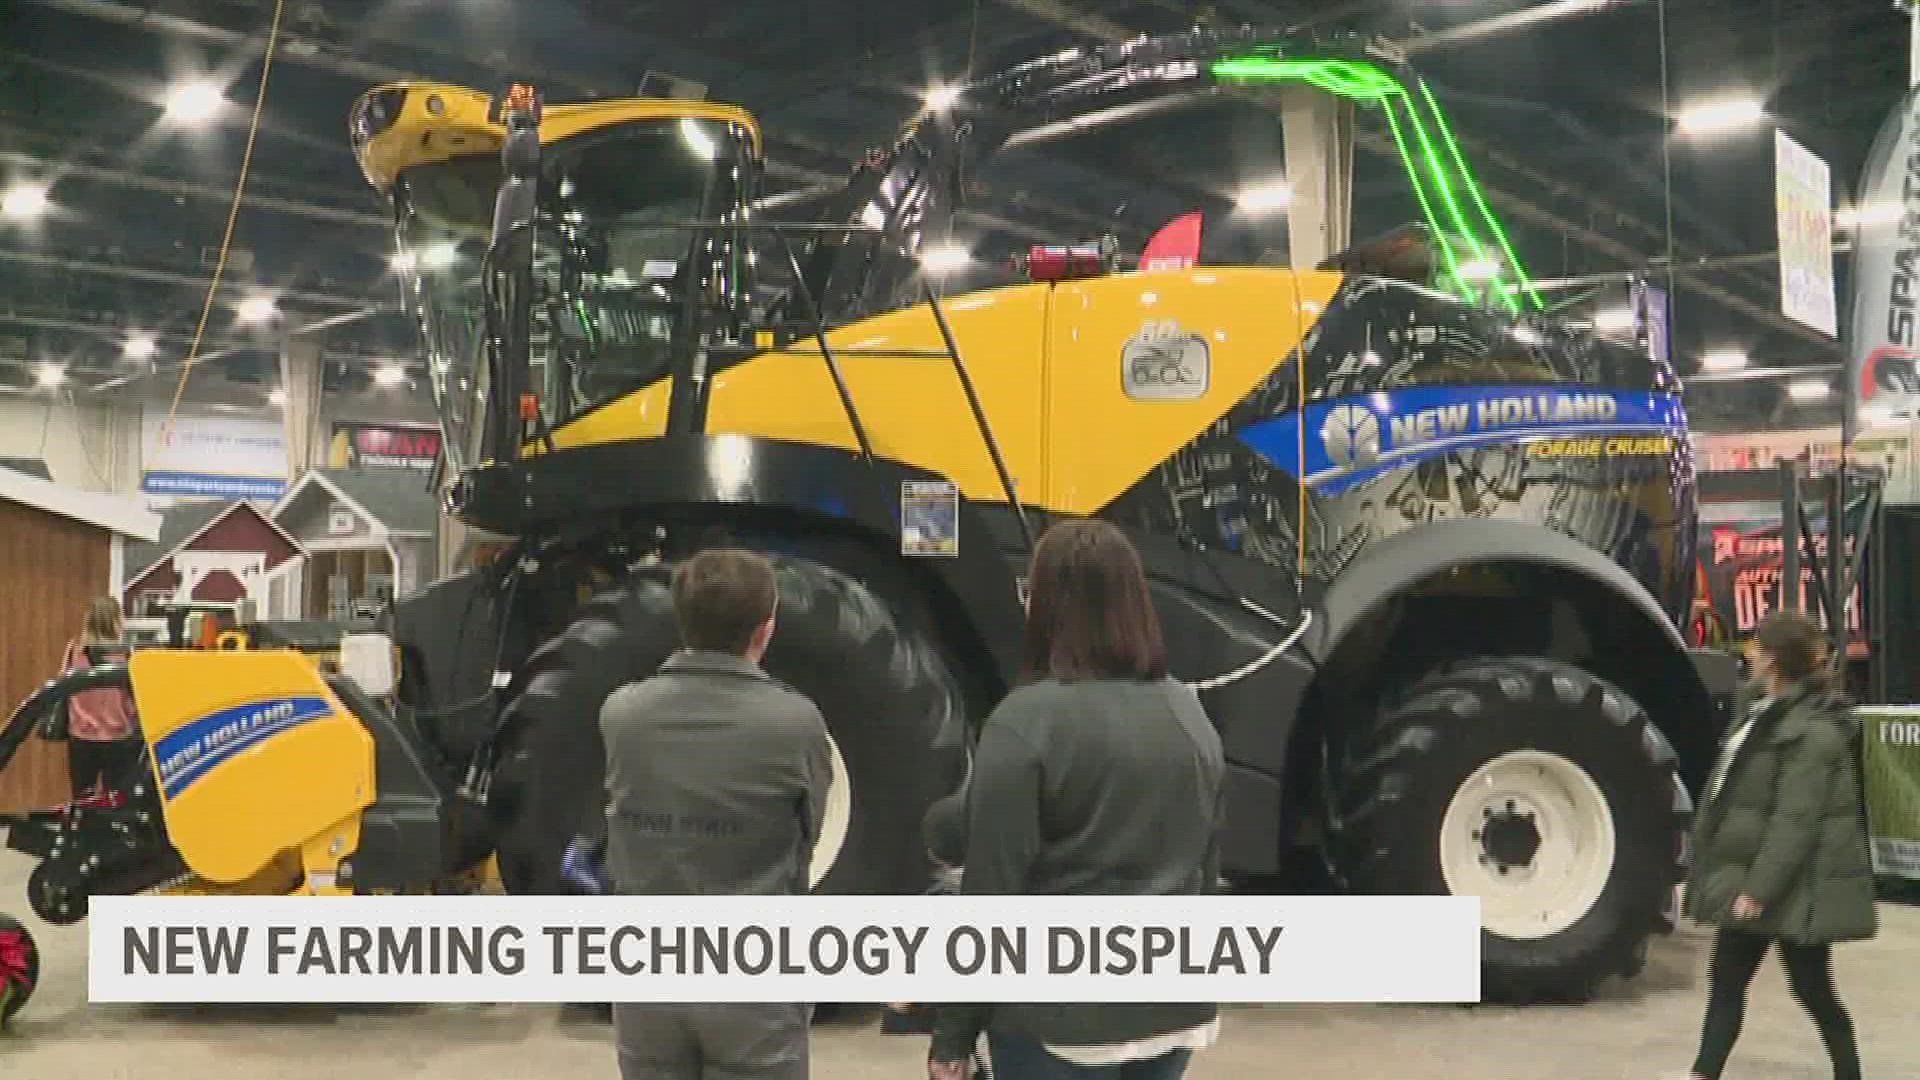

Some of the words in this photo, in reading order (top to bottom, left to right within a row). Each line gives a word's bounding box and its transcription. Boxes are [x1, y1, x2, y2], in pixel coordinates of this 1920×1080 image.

[1391, 404, 1469, 441] NEW
[1477, 394, 1617, 428] HOLLAND
[1527, 440, 1601, 458] FORAGE
[160, 739, 201, 776] NEW
[204, 702, 295, 747] HOLLAND
